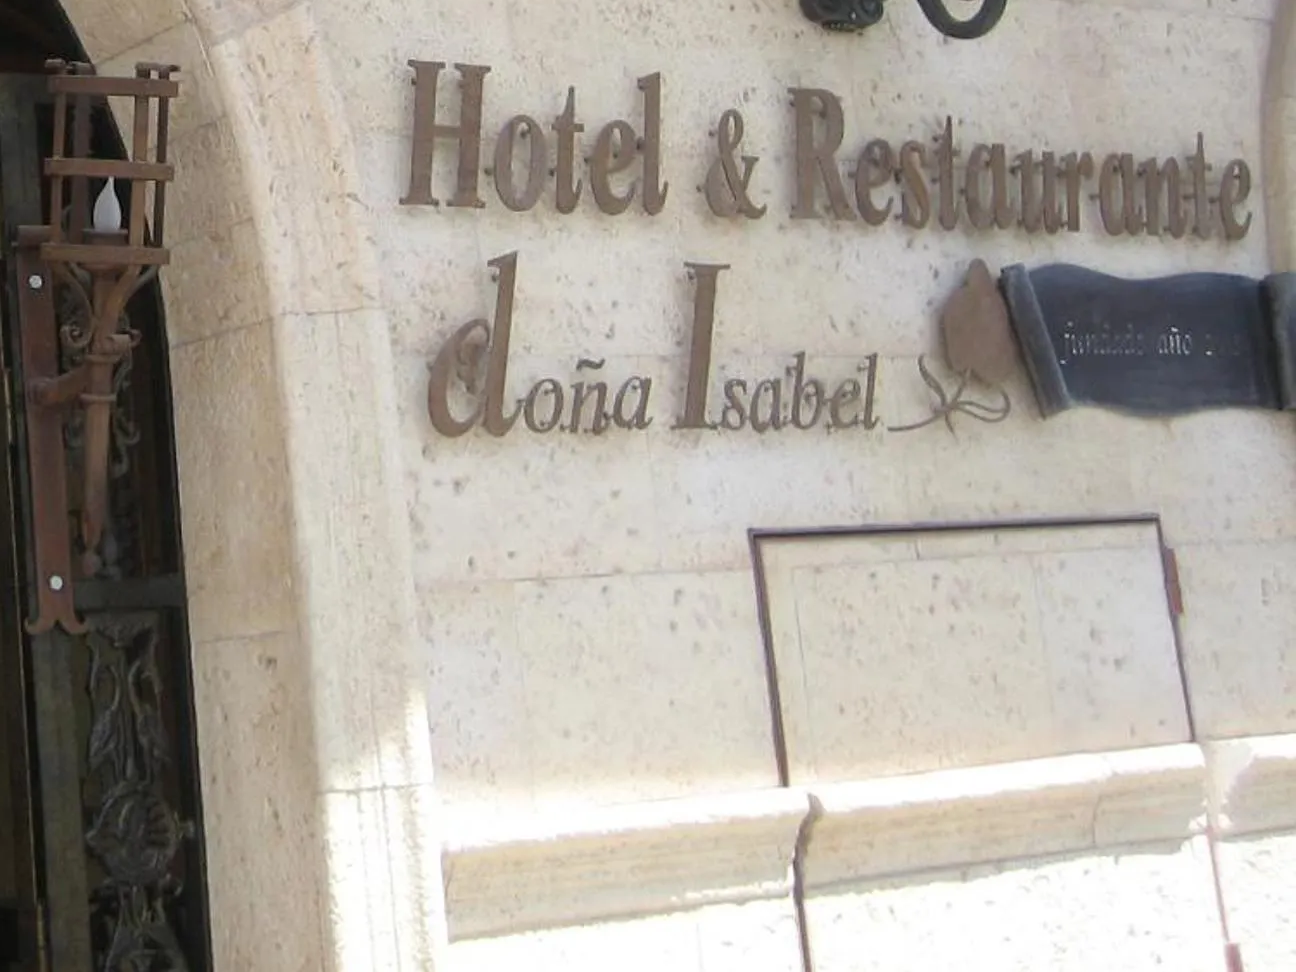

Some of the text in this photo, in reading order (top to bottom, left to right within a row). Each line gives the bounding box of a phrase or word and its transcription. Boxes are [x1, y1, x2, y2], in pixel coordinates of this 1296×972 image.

[399, 59, 1252, 240] Hotel & Restaurante
[428, 251, 880, 438] doña Isabel
[1157, 326, 1193, 356] año
